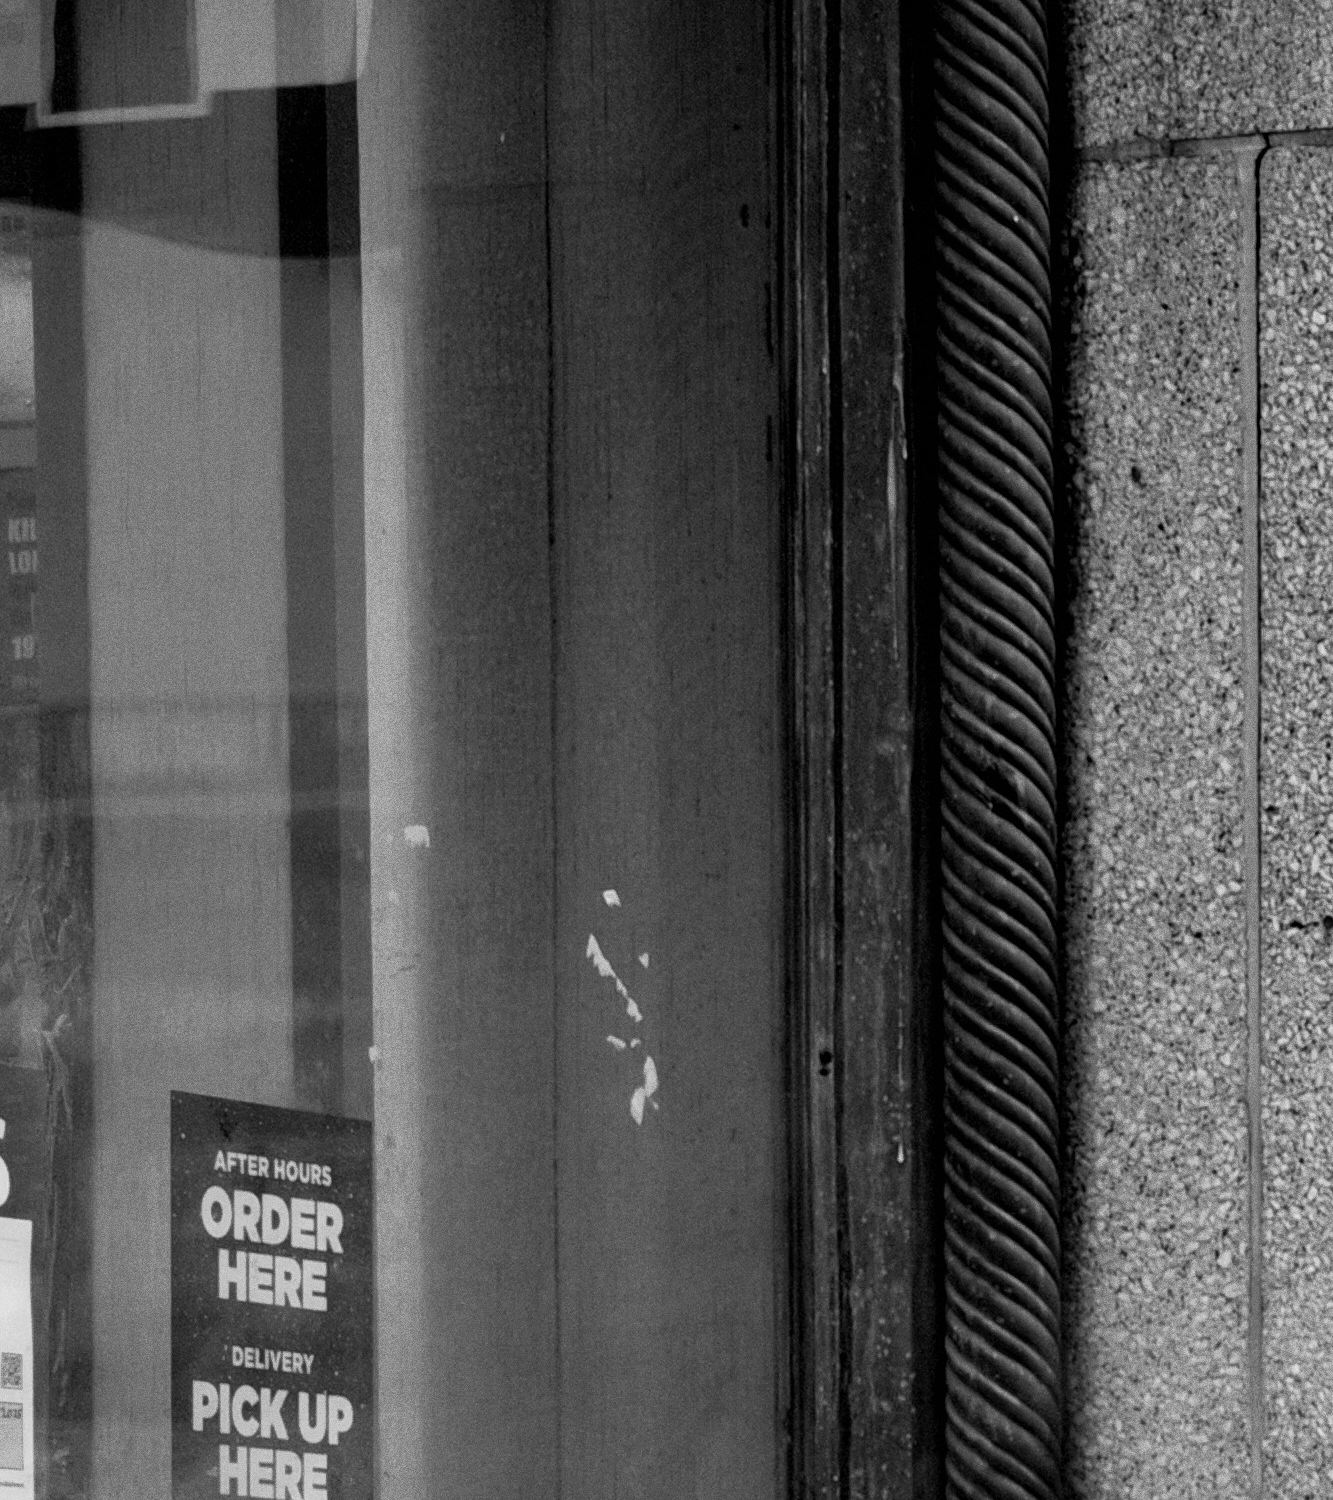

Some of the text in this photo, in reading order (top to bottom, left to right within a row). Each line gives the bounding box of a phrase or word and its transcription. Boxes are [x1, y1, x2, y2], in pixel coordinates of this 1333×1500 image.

[213, 1150, 332, 1188] AFTER HOURS
[201, 1185, 344, 1254] ORDER
[218, 1248, 327, 1312] HERE
[232, 1345, 315, 1375] DELIVERY
[192, 1380, 353, 1446] PICK UP
